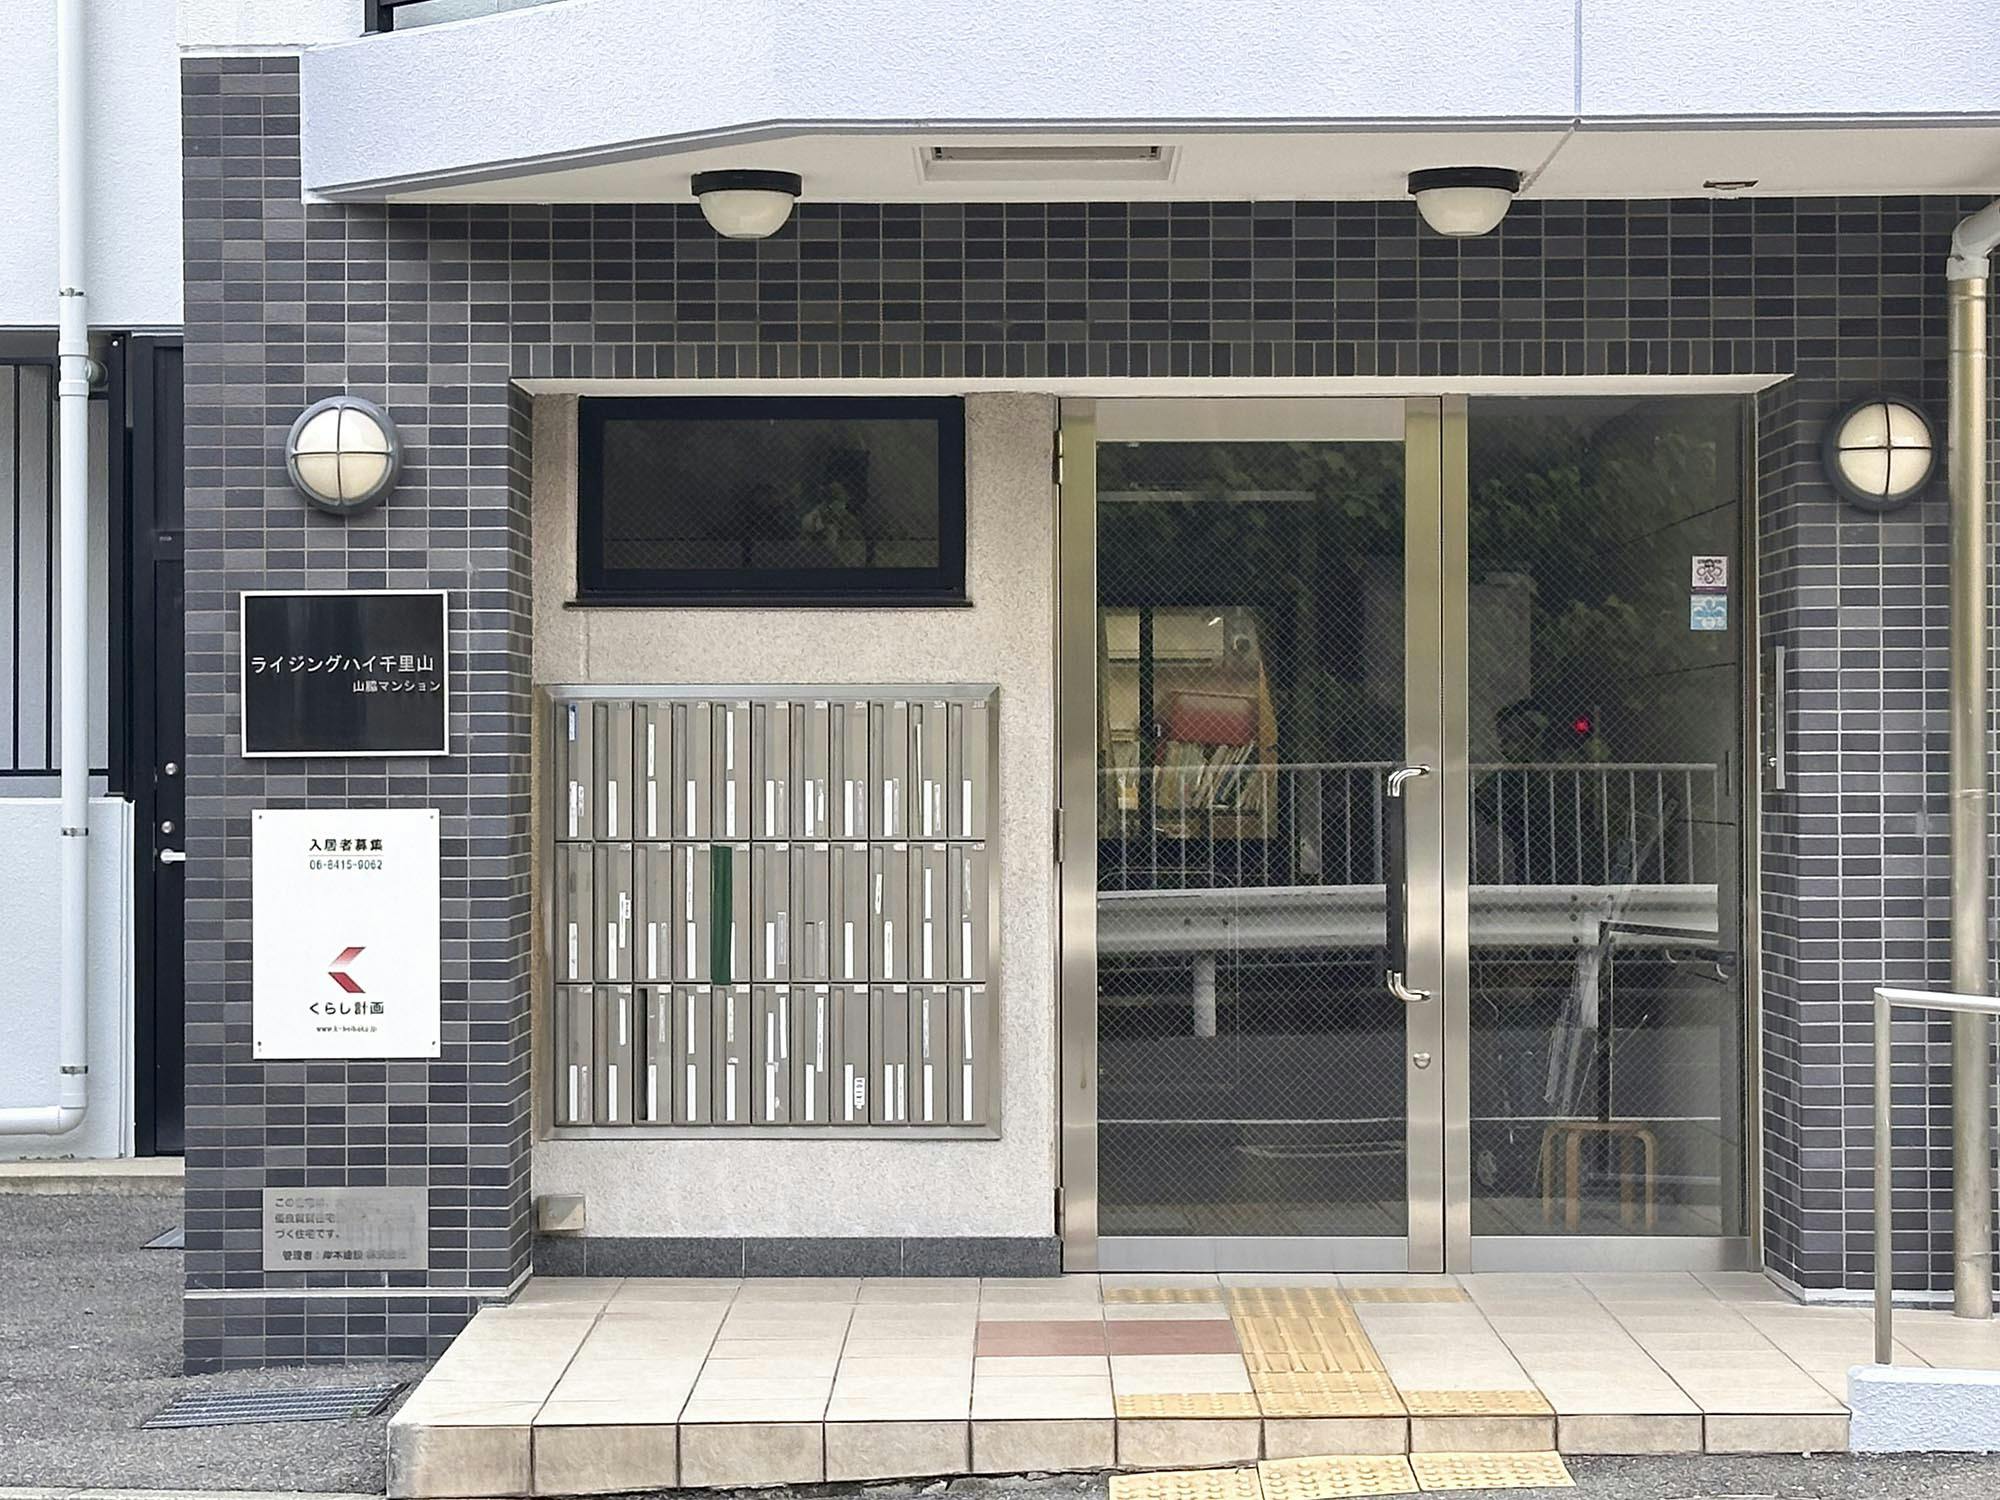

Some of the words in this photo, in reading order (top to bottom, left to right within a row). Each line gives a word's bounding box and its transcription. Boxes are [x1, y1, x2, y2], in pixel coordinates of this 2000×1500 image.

[251, 654, 434, 674] ライジングハイ千里山
[309, 838, 383, 851] 入居者募集
[309, 1001, 384, 1015] くらし計画
